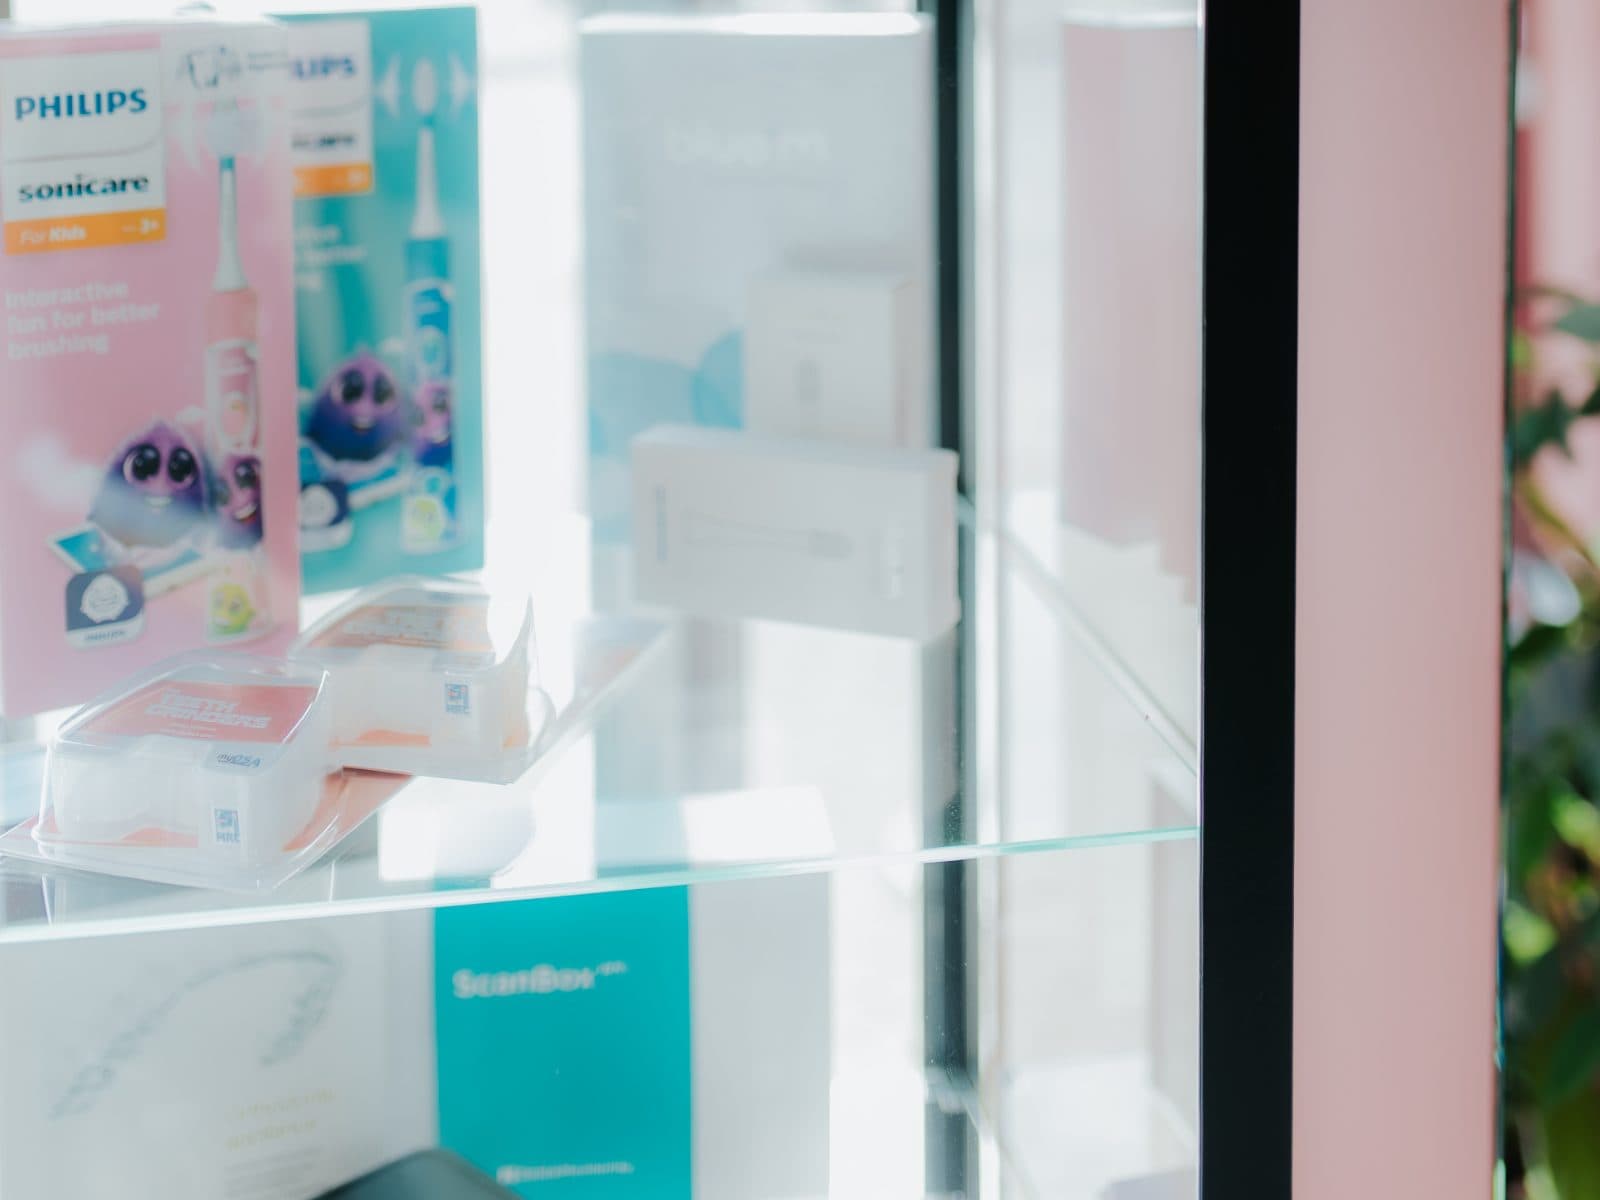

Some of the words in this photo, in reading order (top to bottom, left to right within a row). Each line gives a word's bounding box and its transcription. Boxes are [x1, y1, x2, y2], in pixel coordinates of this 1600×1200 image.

[14, 88, 148, 121] PHILIPS
[18, 173, 150, 203] sonicare
[49, 225, 87, 241] Kids
[5, 282, 129, 309] Interactive
[51, 308, 87, 329] for
[90, 302, 162, 326] better
[8, 333, 110, 360] brushing
